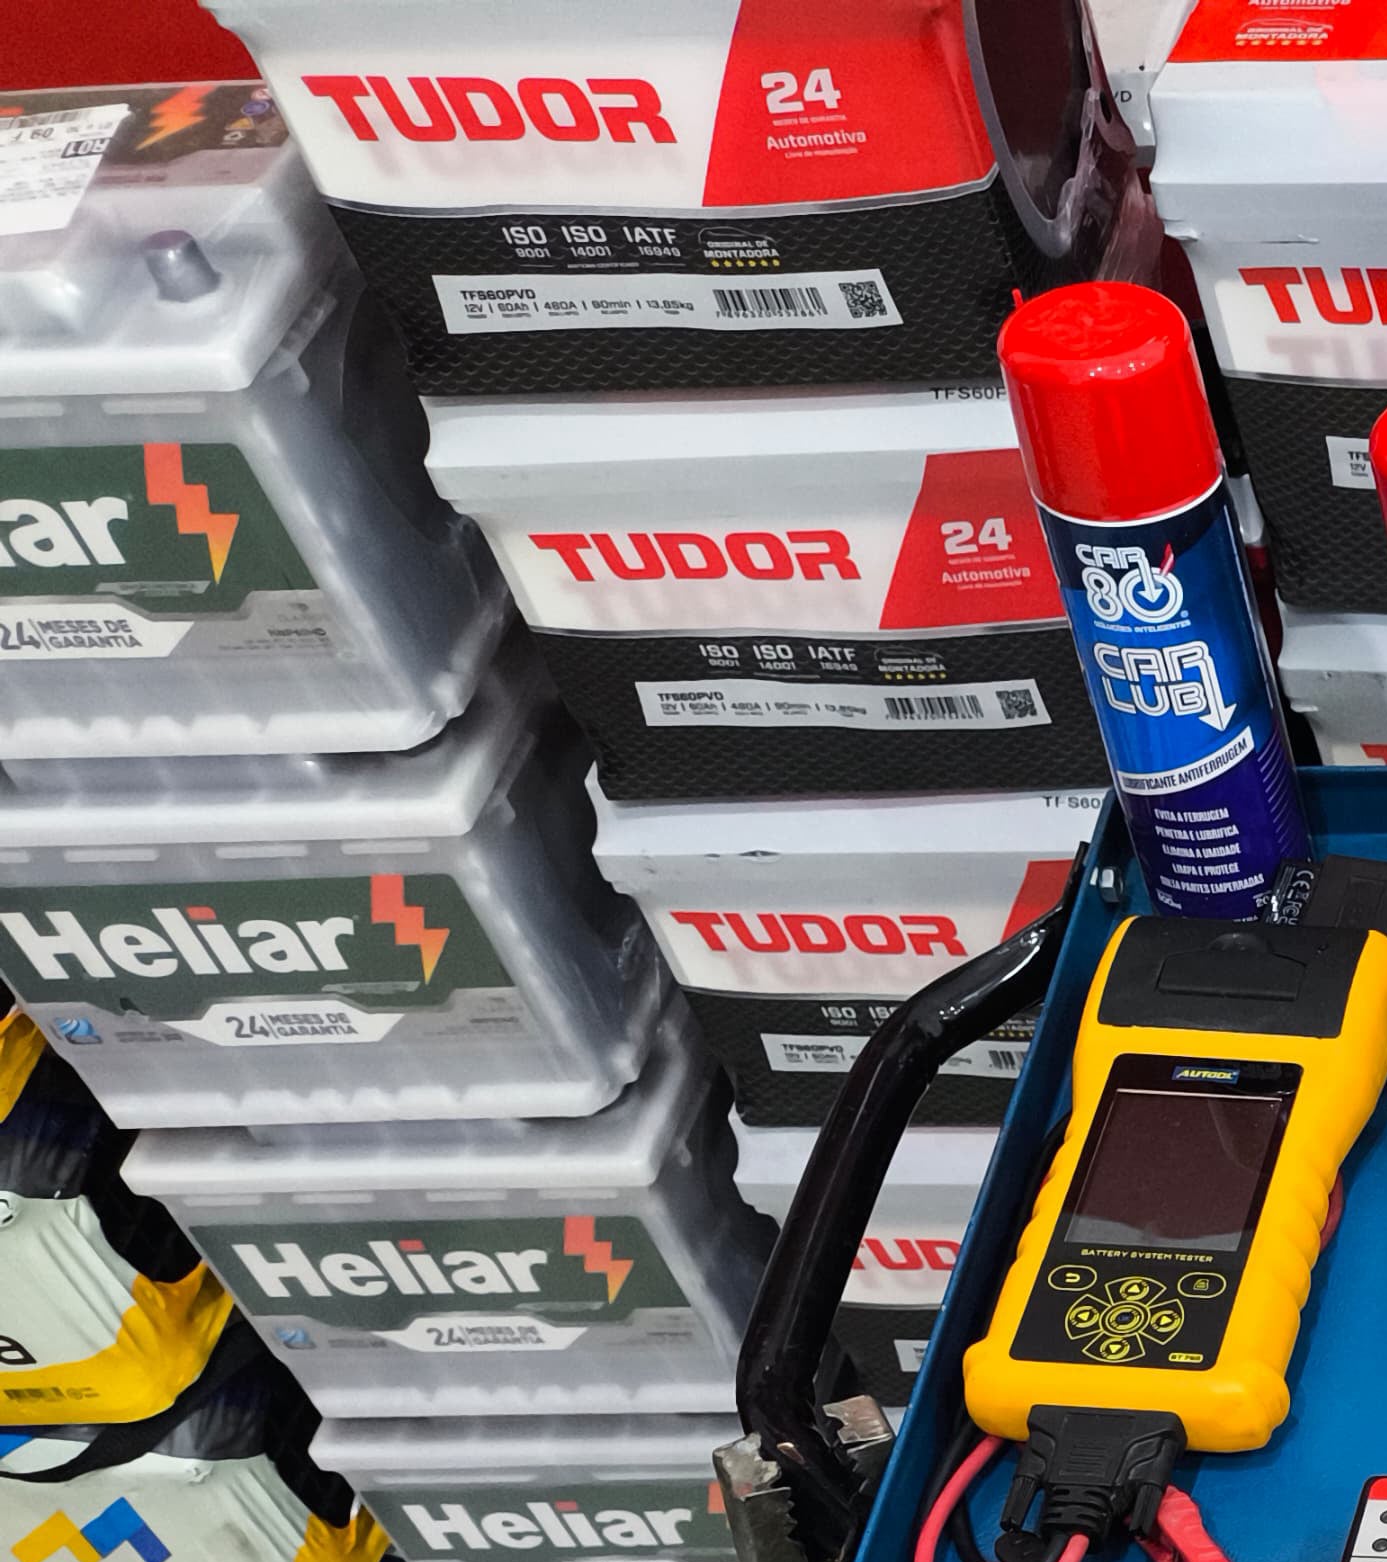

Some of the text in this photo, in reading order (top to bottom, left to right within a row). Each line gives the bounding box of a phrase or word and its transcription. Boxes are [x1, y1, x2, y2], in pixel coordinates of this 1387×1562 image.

[761, 68, 842, 114] 24
[302, 75, 677, 143] TUDOR
[766, 129, 867, 151] Automotiva
[501, 225, 677, 245] ISO ISO IATF
[515, 245, 681, 258] 9001 14001 16949
[704, 247, 779, 259] MONTADORA
[940, 518, 1013, 556] 24
[528, 530, 862, 581] TUDOR
[941, 564, 1032, 586] Automotiva
[42, 619, 132, 633] MESES DE
[48, 636, 142, 648] GARANTIA
[699, 644, 857, 662] ISO ISO IATF
[1178, 738, 1249, 787] ANTIFERRUGEM
[0, 907, 355, 980] Heliar
[671, 911, 968, 956] TUDOR
[226, 1015, 269, 1039] 24
[1081, 1248, 1213, 1263] BATTERY SYSTEM TESTER
[233, 1239, 548, 1298] Heliar
[427, 1328, 466, 1346] 24
[402, 1500, 692, 1551] Heliar
